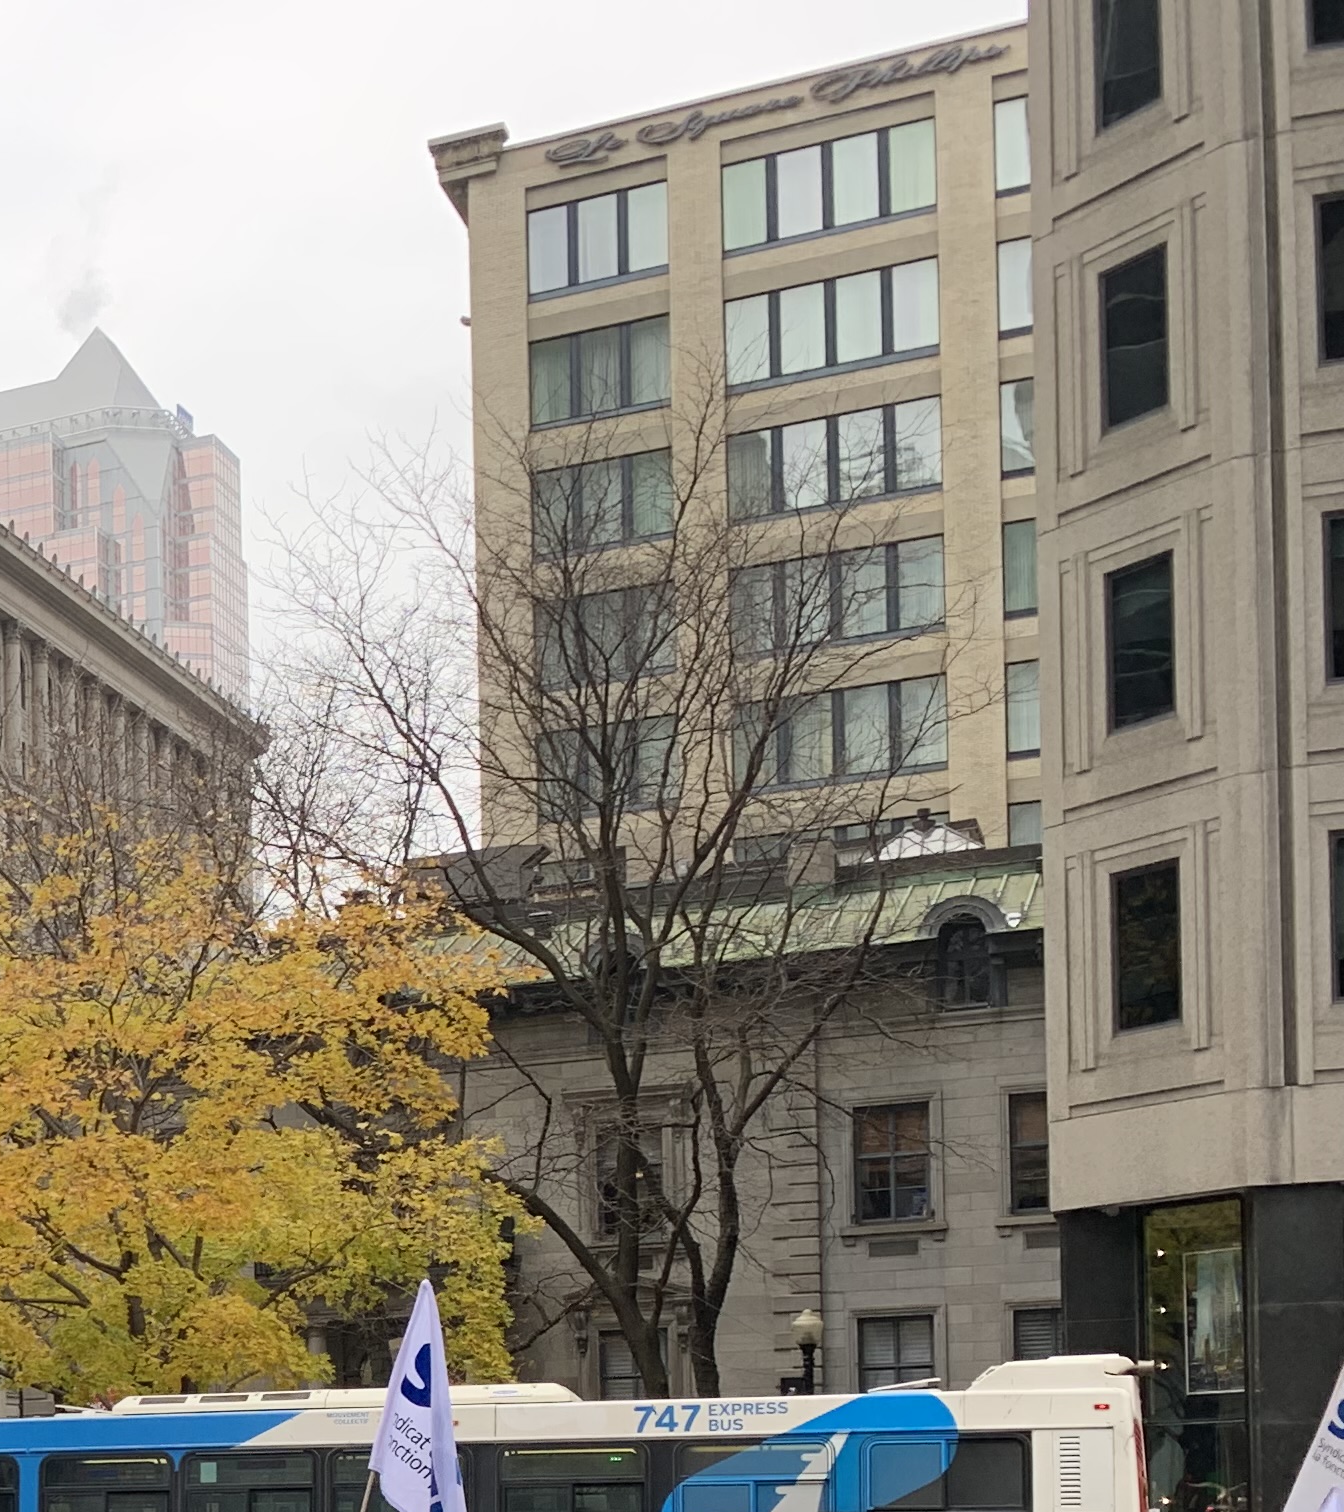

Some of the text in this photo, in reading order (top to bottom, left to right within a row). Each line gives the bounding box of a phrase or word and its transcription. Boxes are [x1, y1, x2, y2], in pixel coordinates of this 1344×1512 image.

[708, 1402, 789, 1417] EXPRESS
[633, 1404, 701, 1433] 747
[708, 1418, 743, 1431] BUS
